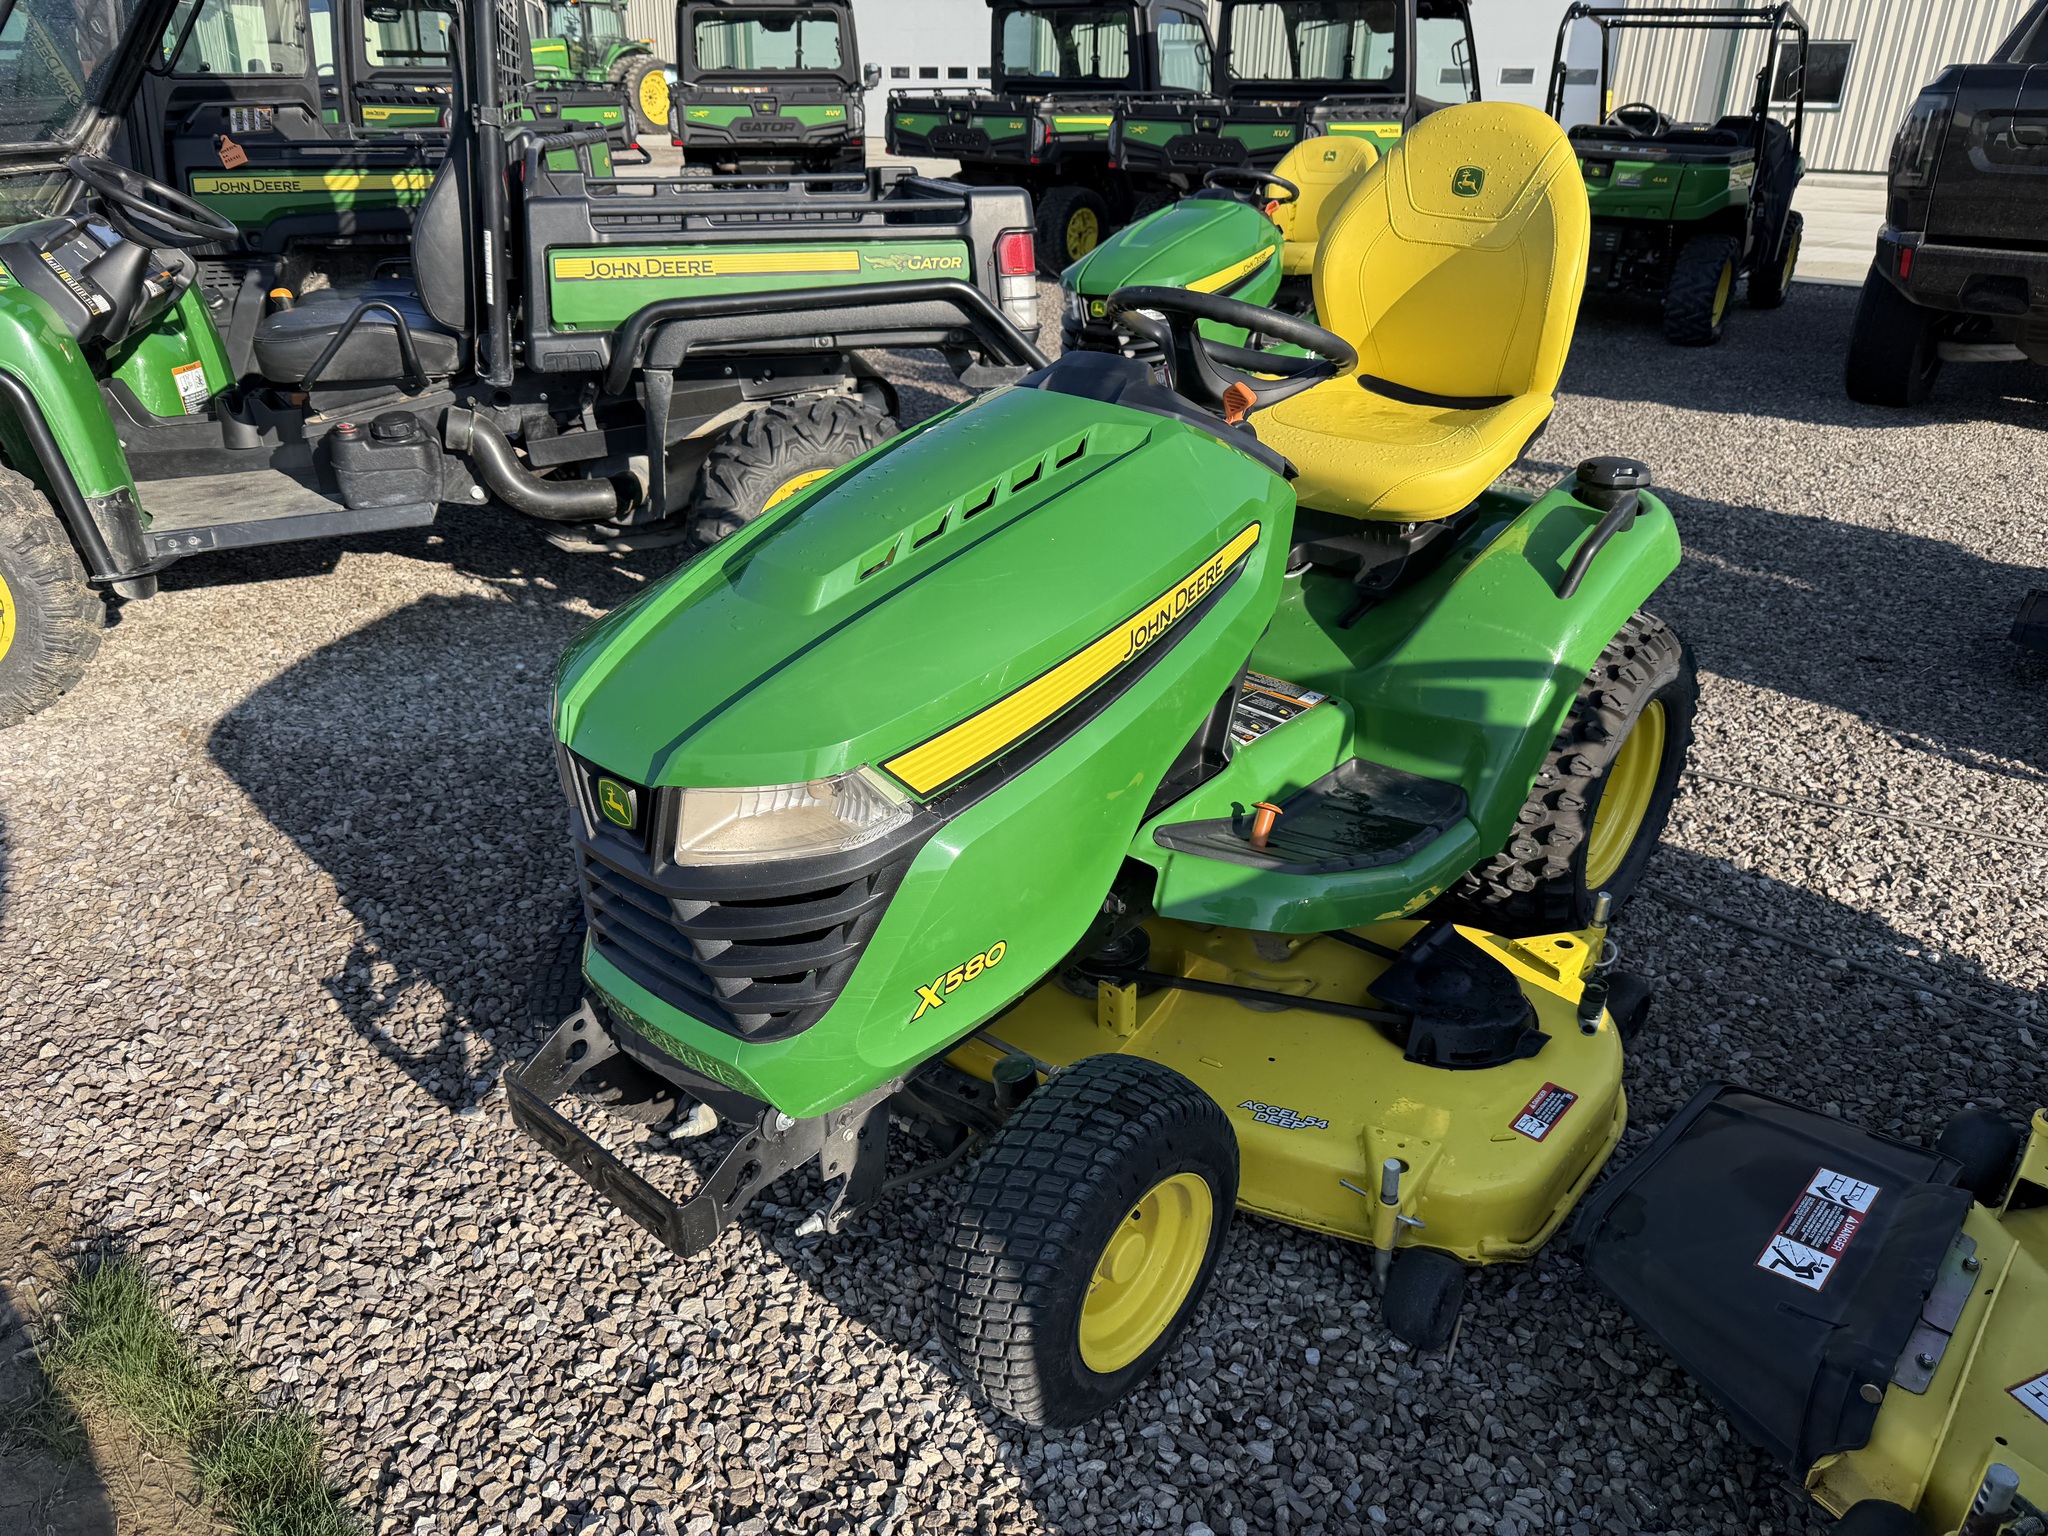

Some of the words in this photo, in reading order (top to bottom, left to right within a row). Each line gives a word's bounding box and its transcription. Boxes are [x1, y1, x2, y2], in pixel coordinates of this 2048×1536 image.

[825, 109, 841, 117] XUV
[739, 121, 797, 132] GATOR
[1273, 129, 1291, 138] XUV
[211, 180, 251, 192] JOHN
[253, 179, 302, 191] DEERE
[585, 260, 642, 276] JOHN
[646, 259, 714, 275] DEERE
[907, 255, 963, 271] GATOR
[1123, 603, 1171, 659] JOHN
[1175, 556, 1224, 615] DEERE
[908, 940, 1008, 1024] X580
[1238, 1100, 1302, 1121] ACCEL
[1252, 1112, 1306, 1130] DEEP
[1304, 1115, 1329, 1129] 54
[1831, 1222, 1855, 1252] DANGER
